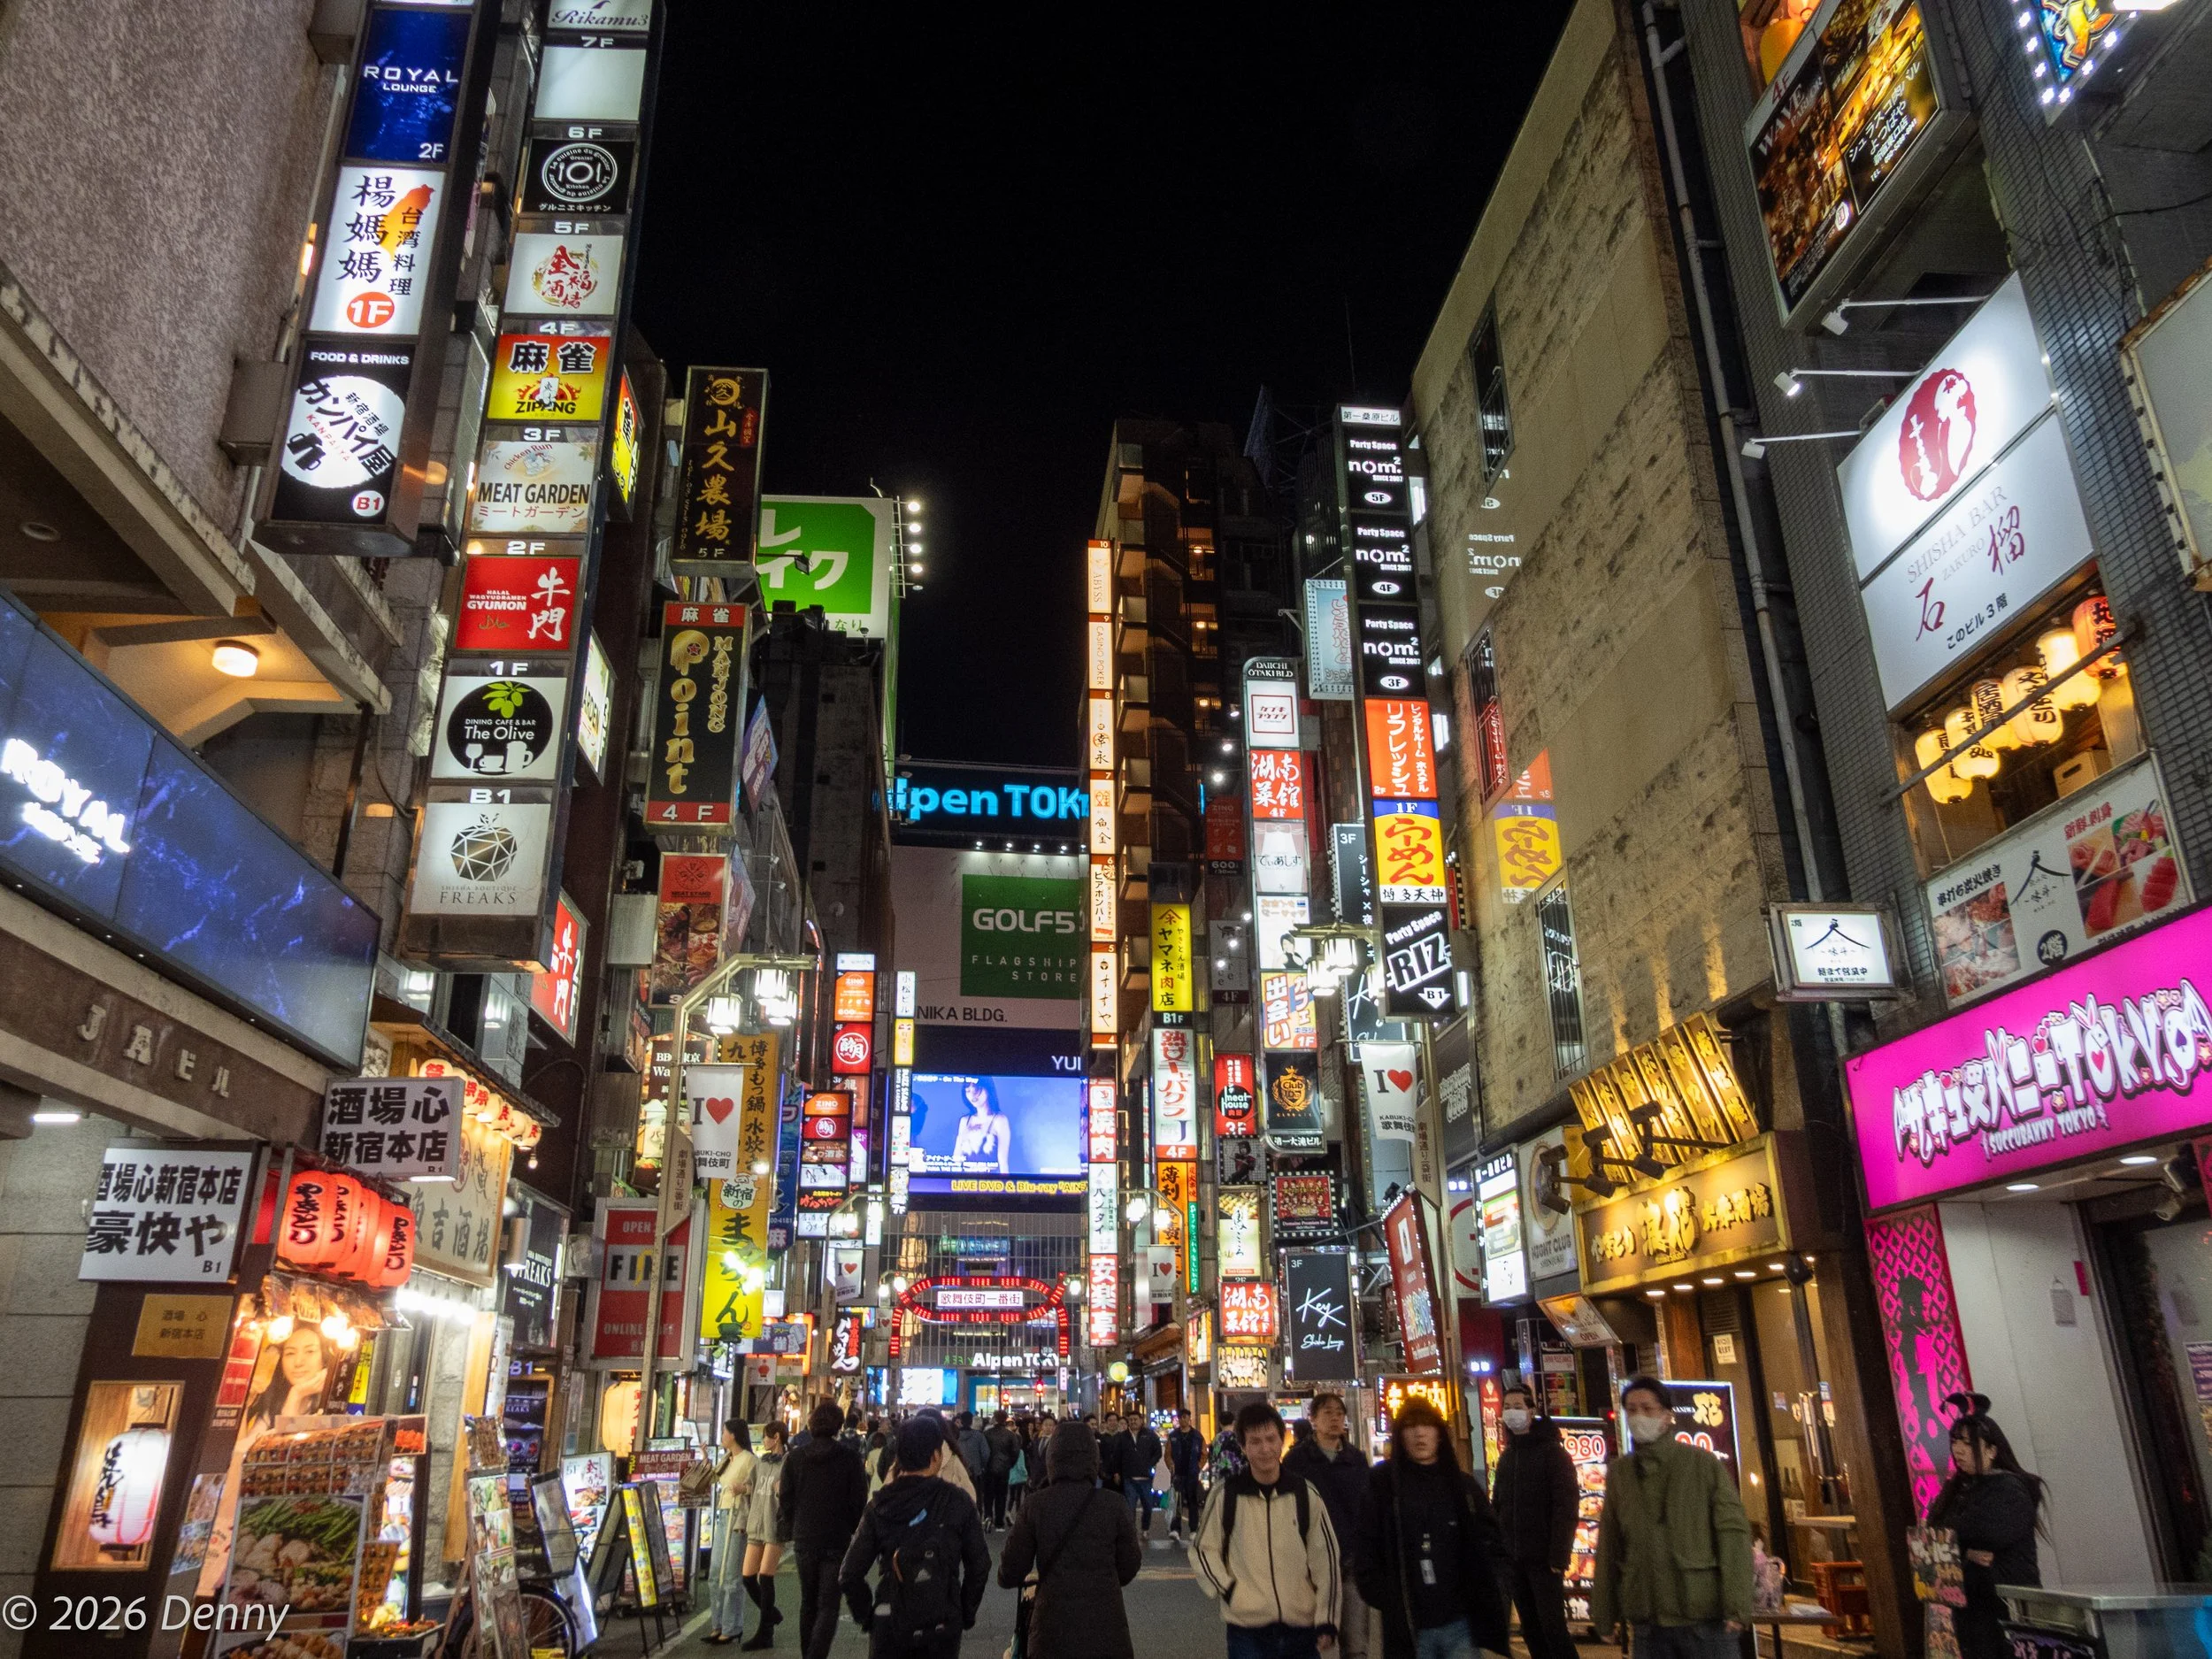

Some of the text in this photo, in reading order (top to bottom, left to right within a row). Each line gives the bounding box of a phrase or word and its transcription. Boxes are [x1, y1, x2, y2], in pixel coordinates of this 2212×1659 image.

[581, 36, 614, 48] 7F
[364, 65, 459, 83] ROYAL
[383, 84, 437, 93] LOUNGE
[1771, 71, 1791, 104] 4F
[1758, 82, 1802, 157] WAVE
[568, 127, 603, 139] 6F
[419, 143, 444, 159] 2F
[539, 203, 612, 212] グルニエキッチン
[336, 175, 396, 283] 楊媽媽
[554, 221, 590, 234] 5F
[388, 207, 424, 296] 台湾料理
[349, 299, 393, 322] 1F
[539, 321, 576, 335] 4F
[310, 351, 410, 365] FOOD & DRINKS
[510, 342, 597, 375] 麻雀
[345, 392, 389, 436] 新宿酒場
[515, 401, 576, 416] ZIPANG
[1343, 411, 1400, 422] 第一桑原ビル
[299, 378, 397, 480] カンパイ屋
[524, 428, 561, 442] 3F
[306, 414, 349, 463] KANPAIYA
[1349, 441, 1396, 450] Party Space
[503, 442, 553, 472] Chicken Run
[695, 409, 737, 545] 山久農場
[479, 483, 591, 505] MEAT GARDEN
[356, 496, 381, 511] B1
[479, 505, 585, 519] ミートガーデン
[1357, 528, 1404, 538] Party Space
[1907, 486, 2008, 586] SHISHA BAR
[507, 541, 546, 555] 2F
[698, 548, 726, 557] 5F
[1941, 537, 1986, 582] ZAKURO
[1093, 574, 1102, 603] ABYSS
[466, 600, 526, 611] GYUMON
[526, 566, 571, 641] 牛門
[680, 607, 733, 623] 麻雀
[1946, 592, 2010, 650] このビル3階
[1365, 620, 1413, 630] Party Space
[490, 661, 529, 676] 1F
[707, 635, 733, 733] MAHJONG
[666, 629, 710, 795] Point
[465, 726, 535, 741] The Olive
[1386, 703, 1410, 796] リフレッシュ
[1411, 703, 1430, 793] レンタルルーム ホステル
[1252, 752, 1301, 782] 湖南
[471, 788, 511, 803] B1
[1253, 781, 1301, 809] 菜館
[1374, 786, 1386, 795] 2F
[662, 804, 713, 820] 4F
[1269, 808, 1286, 818] 4F
[1395, 803, 1417, 813] 1F
[1340, 833, 1356, 844] 3F
[1385, 817, 1434, 885] らーめん
[440, 891, 518, 904] FREAKS
[1383, 888, 1444, 902] 博多天神
[973, 909, 1075, 933] GOLF5
[1386, 910, 1442, 946] Party Space
[1108, 943, 1115, 952] 5
[2039, 934, 2065, 961] 2階
[972, 955, 1077, 967] FLAGSHIP
[1158, 927, 1175, 1007] ヤマネ肉店
[845, 977, 865, 986] ZINO
[1011, 972, 1077, 983] STORE
[1294, 975, 1311, 1026] カフェ
[1426, 990, 1444, 1000] B1
[963, 1007, 1007, 1022] BLDG.
[1163, 1013, 1184, 1024] B1F
[1265, 974, 1291, 1047] 出会い
[1298, 1037, 1315, 1047] 1F
[745, 1039, 768, 1114] 博多もつ鍋
[1373, 1070, 1389, 1094] I
[1225, 1087, 1252, 1102] meat
[327, 1086, 449, 1125] 酒場心
[1221, 1097, 1249, 1116] house
[2058, 1108, 2096, 1138] TOKYO
[324, 1131, 449, 1165] 新宿本店
[1165, 1145, 1187, 1158] 4F
[96, 1164, 243, 1205] 酒場心新宿本店
[951, 1180, 1058, 1194] LIVE DVD & Blu-ray
[892, 1204, 906, 1215] 7F
[85, 1211, 228, 1256] 豪快や
[623, 1222, 652, 1233] OPEN
[1532, 1242, 1553, 1260] NIGHT
[1554, 1235, 1572, 1253] CLUB
[203, 1261, 221, 1274] B1
[1291, 1259, 1303, 1268] 3F
[941, 1293, 1021, 1305] 歌舞伎町一番街
[1090, 1256, 1118, 1340] 安楽亭
[1225, 1284, 1270, 1310] 湖南
[1296, 1287, 1347, 1328] Key
[604, 1323, 644, 1334] ONLINE
[1580, 1332, 1599, 1340] OPEN
[972, 1352, 1023, 1370] Alpen
[640, 1452, 691, 1463] MEAT GARDEN
